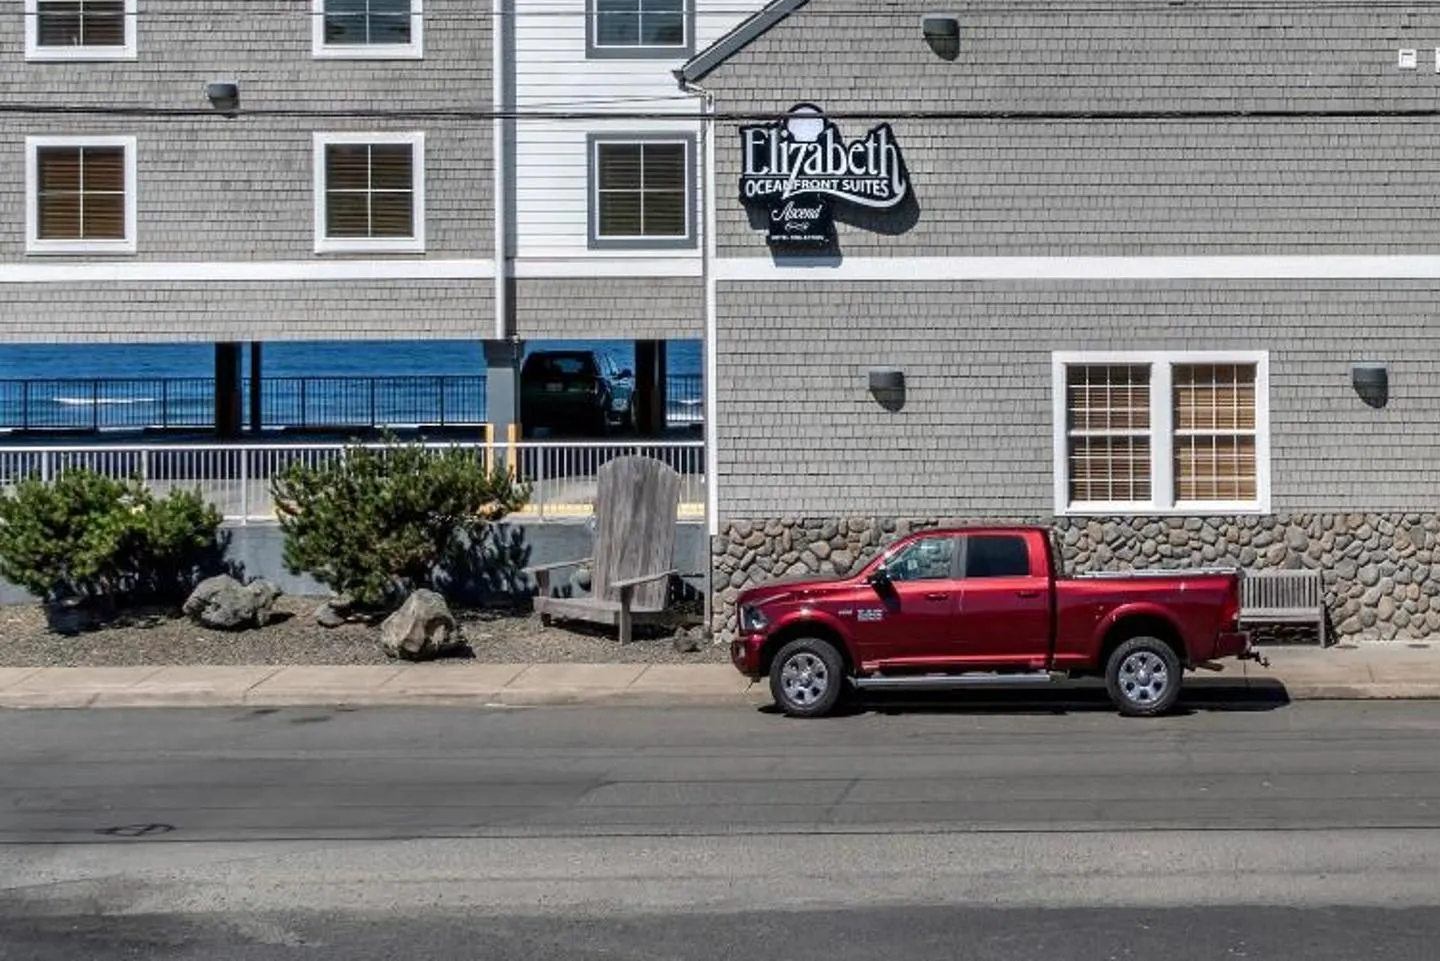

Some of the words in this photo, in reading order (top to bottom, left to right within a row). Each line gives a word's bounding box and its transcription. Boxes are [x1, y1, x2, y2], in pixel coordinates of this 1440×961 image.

[744, 126, 906, 198] Elizabeth
[745, 179, 839, 197] OCEANFRONT
[842, 179, 889, 197] SUITES
